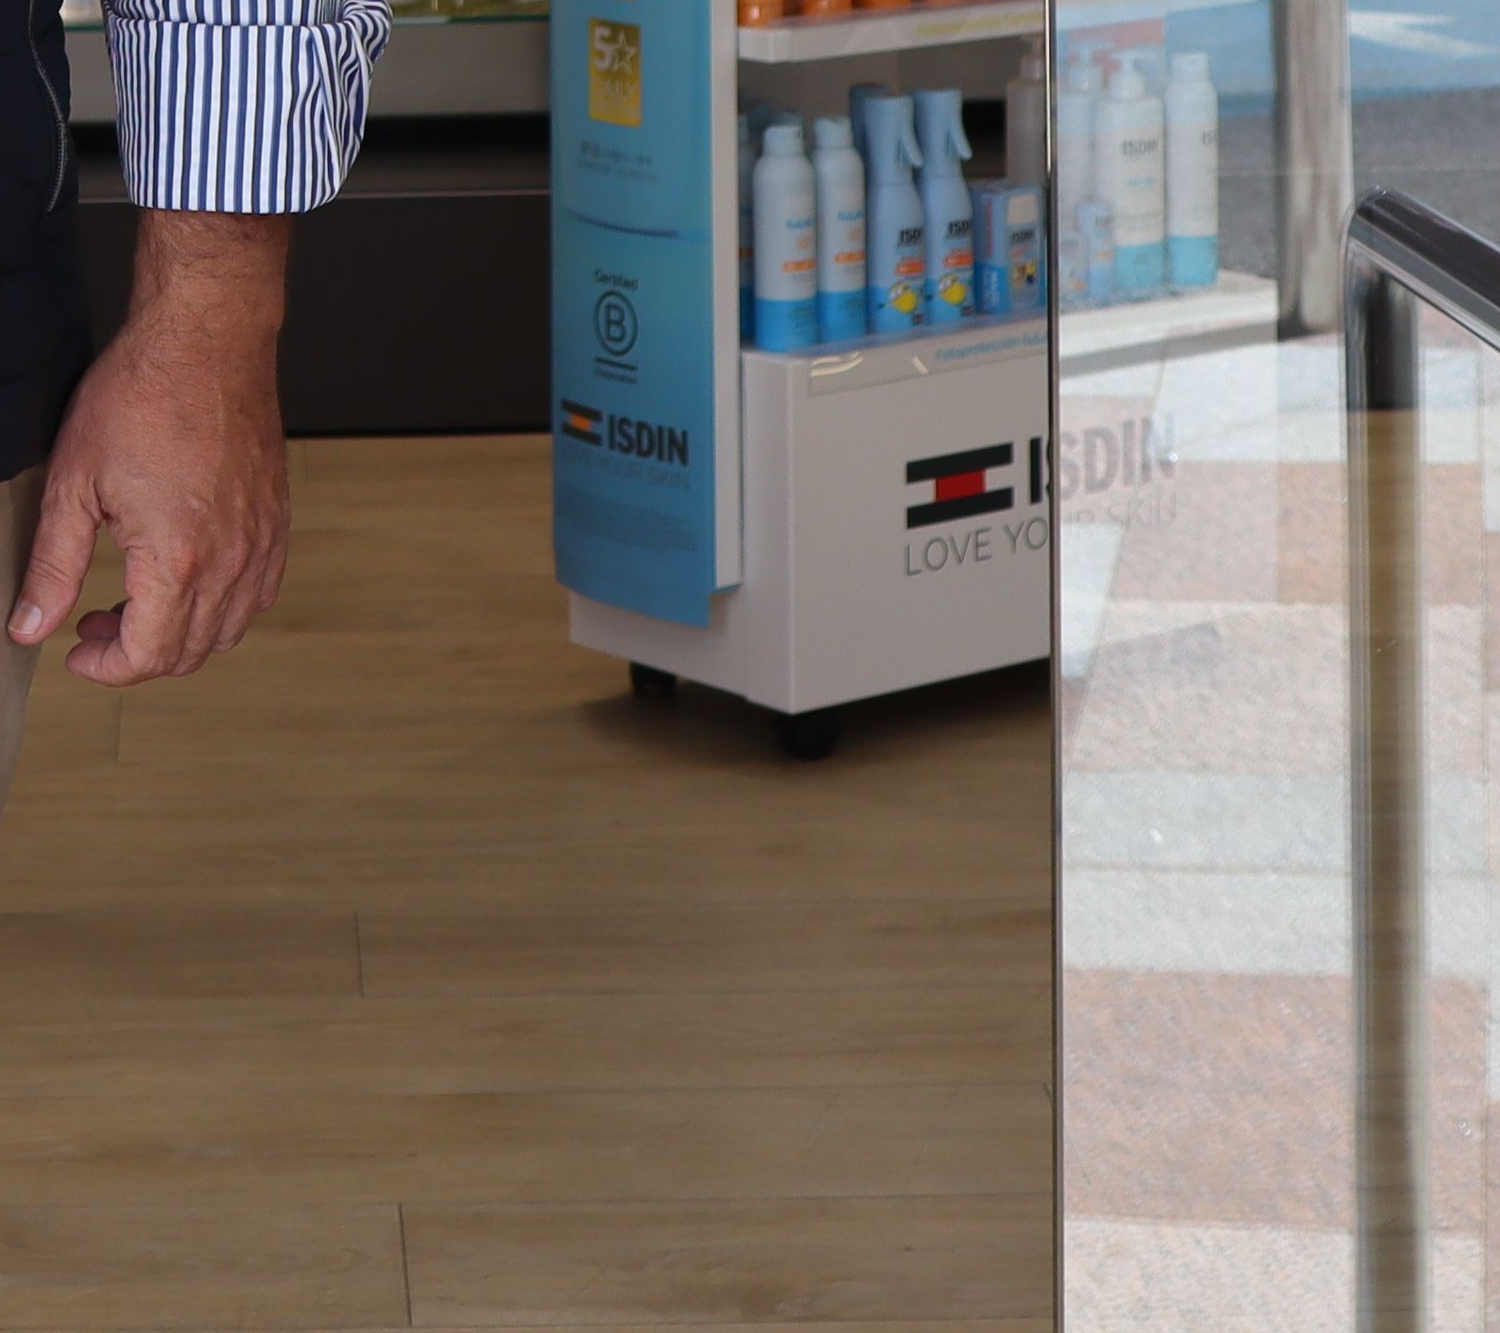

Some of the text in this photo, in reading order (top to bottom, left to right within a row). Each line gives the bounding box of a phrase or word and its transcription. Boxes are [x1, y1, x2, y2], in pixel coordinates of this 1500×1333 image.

[593, 268, 639, 292] Certified
[606, 303, 626, 343] B
[606, 413, 690, 467] ISDIN
[1028, 413, 1178, 506] ISDIN
[904, 525, 993, 578] LOVE
[1108, 483, 1178, 527] SKIN
